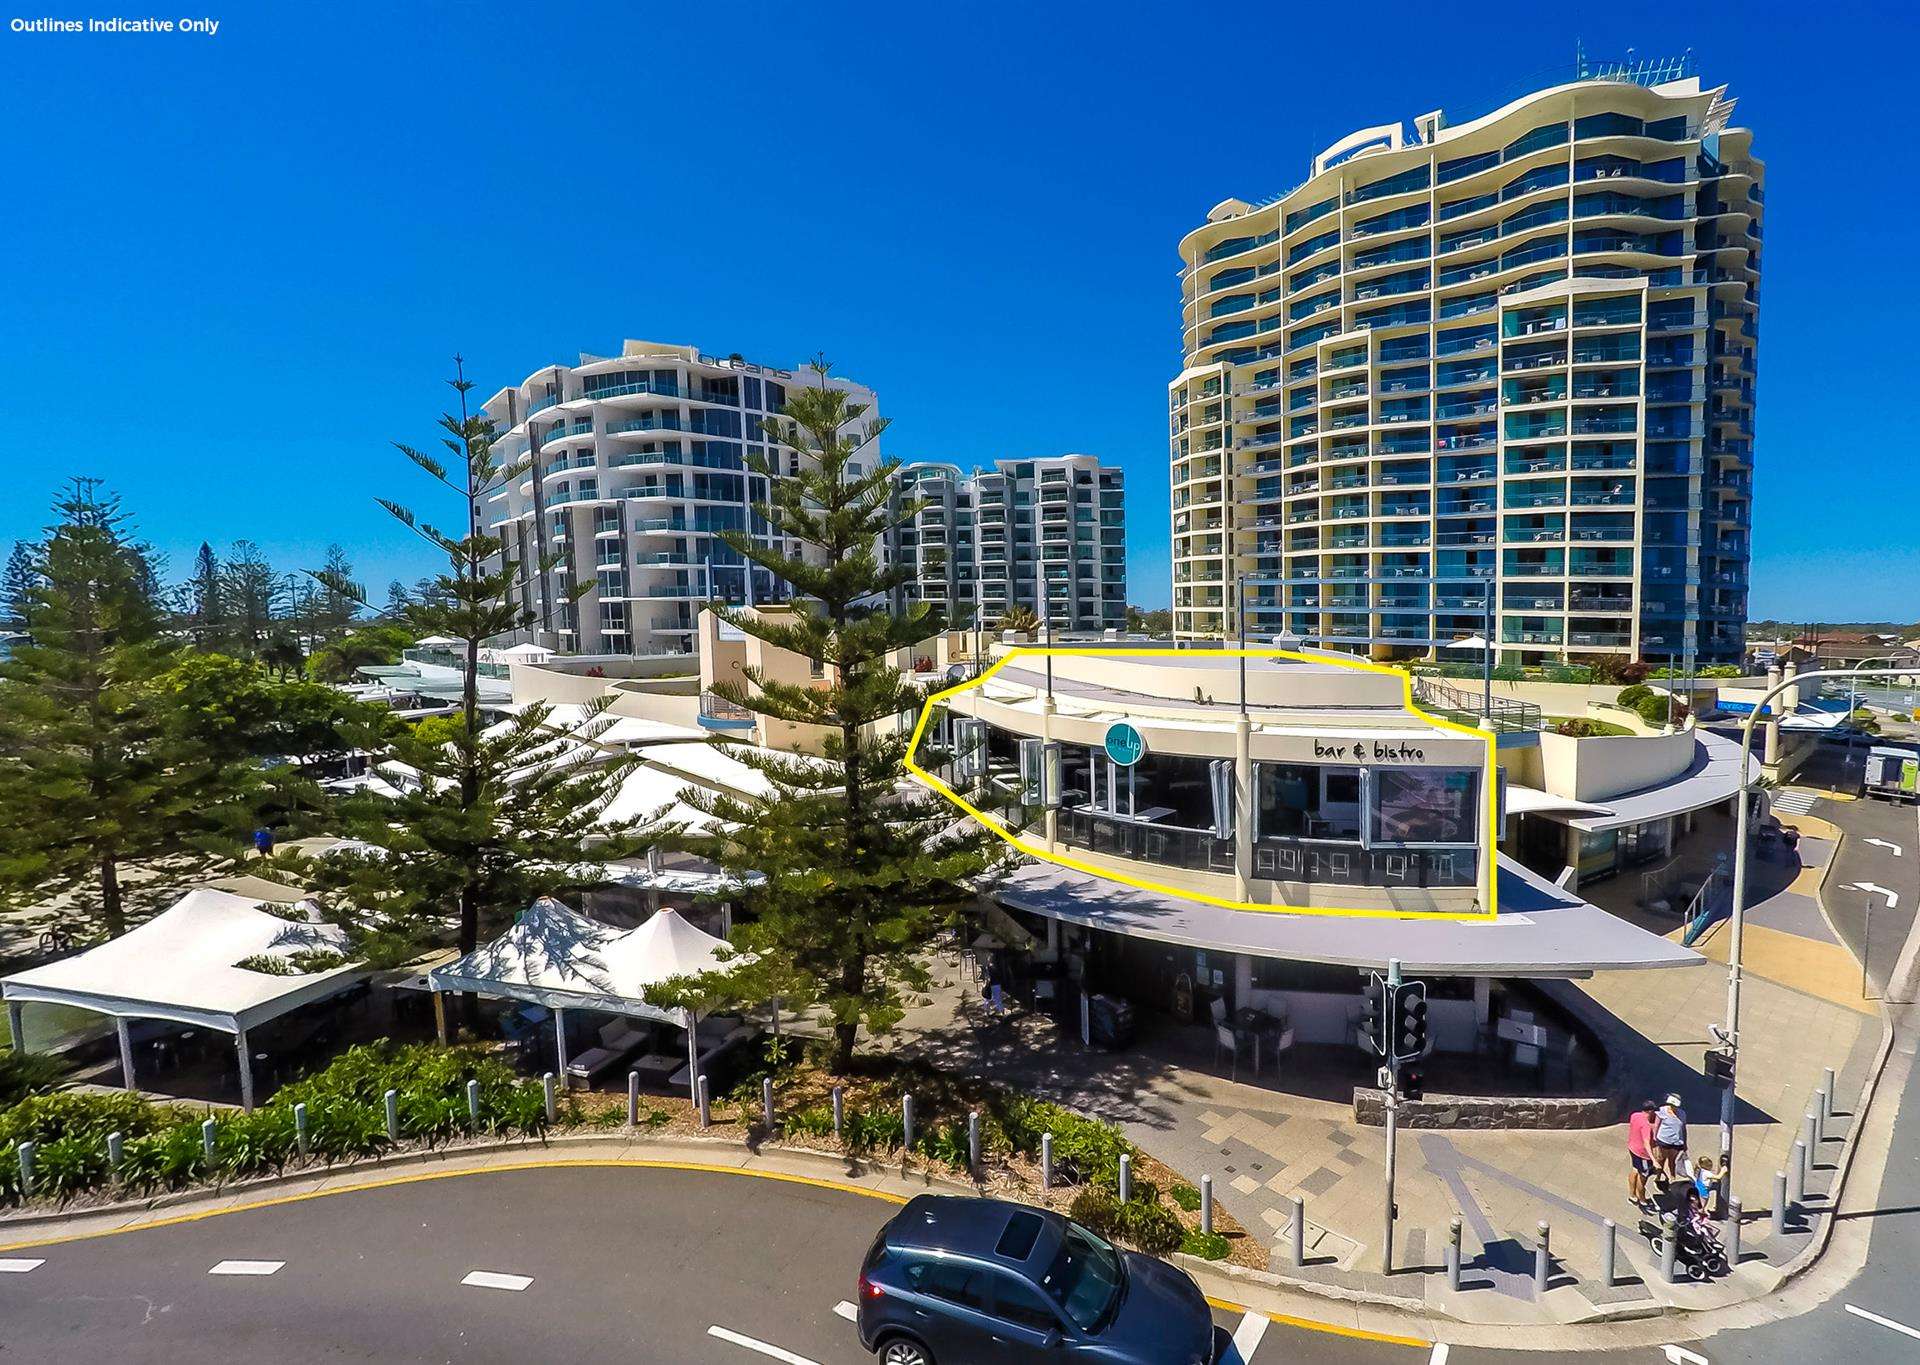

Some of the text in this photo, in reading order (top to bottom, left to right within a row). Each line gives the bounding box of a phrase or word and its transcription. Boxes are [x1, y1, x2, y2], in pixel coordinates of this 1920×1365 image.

[698, 354, 792, 379] oceans
[1314, 739, 1424, 760] bar & bistro
